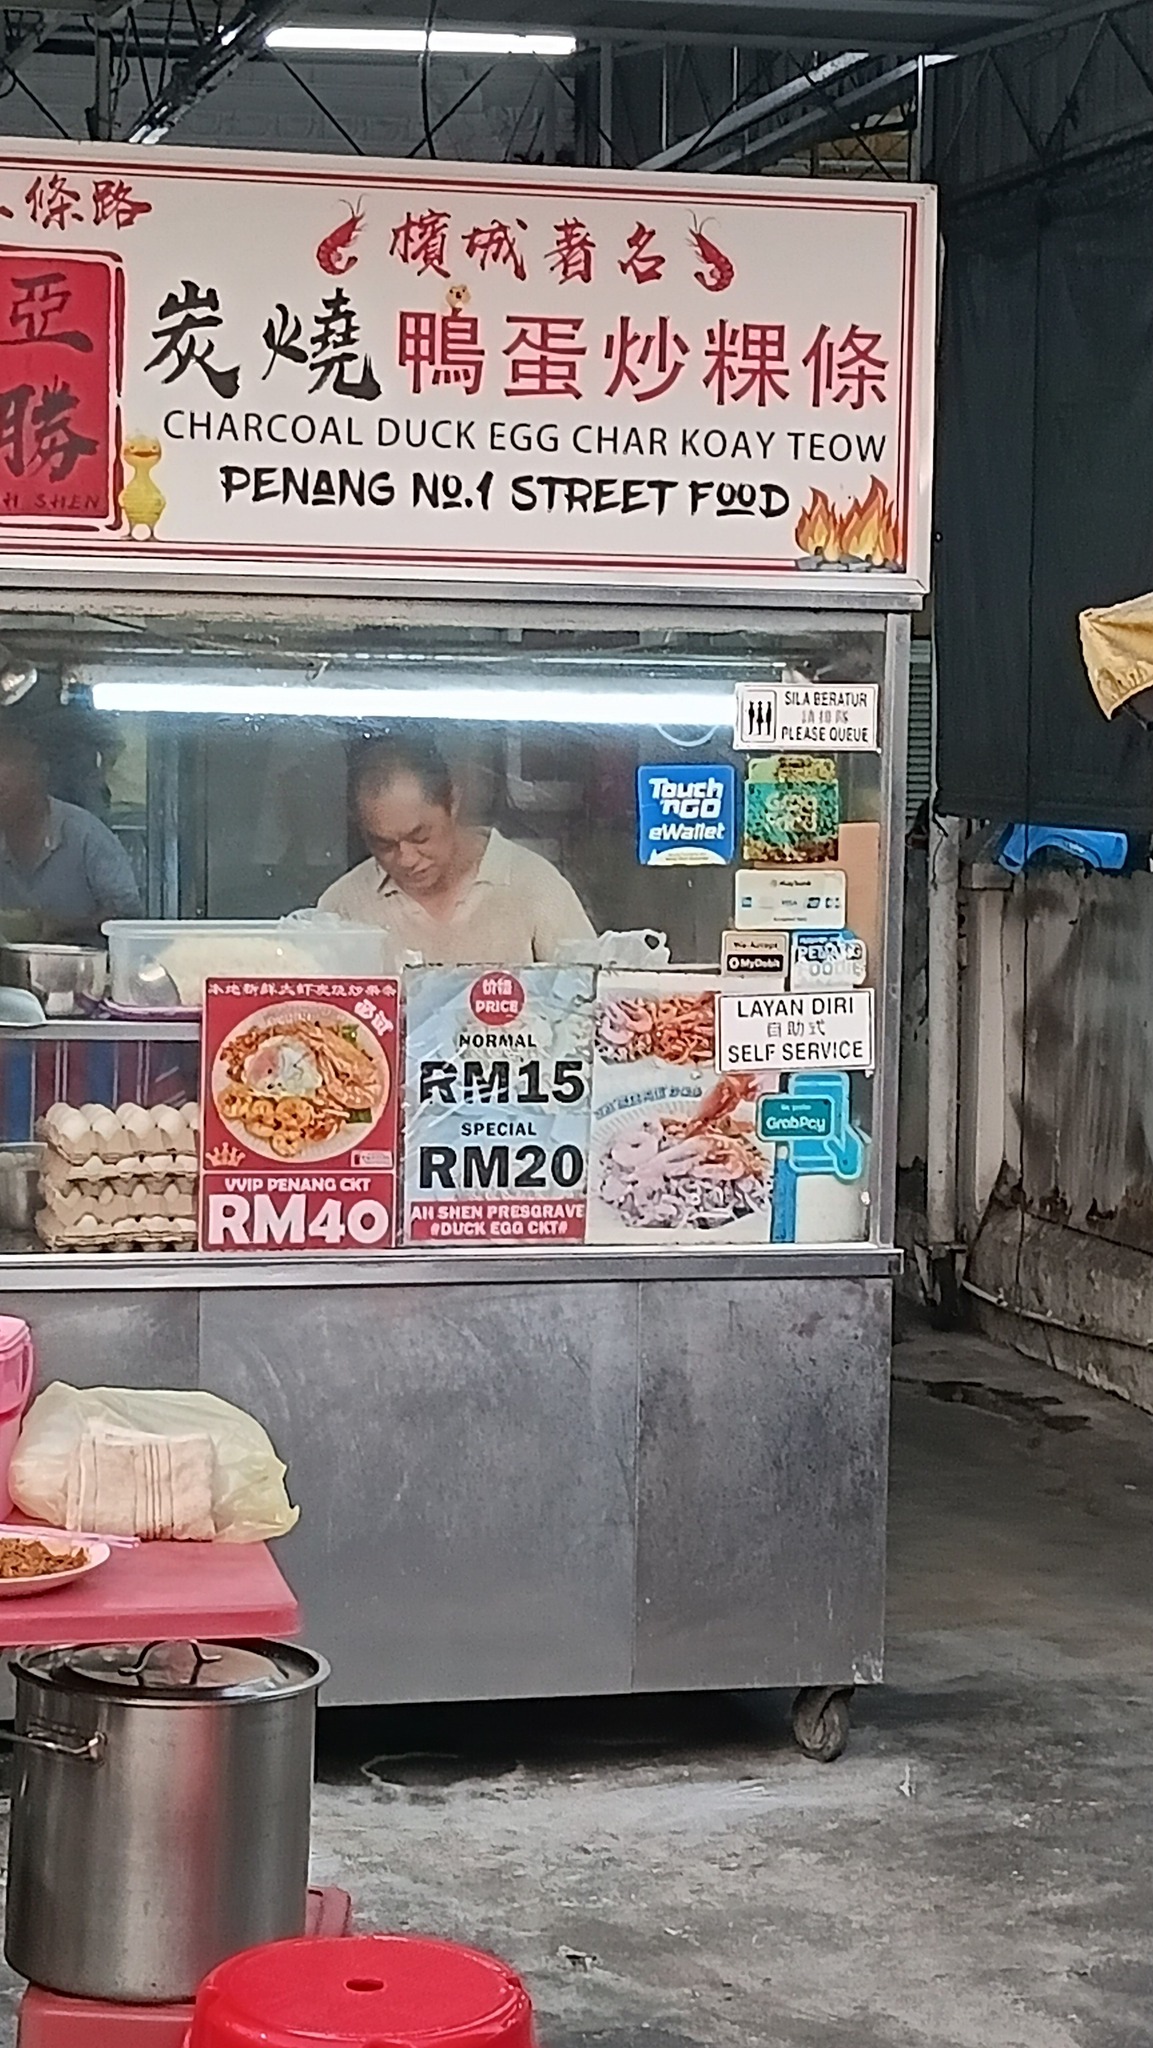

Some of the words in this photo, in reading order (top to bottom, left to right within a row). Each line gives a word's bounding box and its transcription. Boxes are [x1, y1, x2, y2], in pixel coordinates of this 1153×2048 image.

[0, 173, 152, 230] 條路
[163, 410, 363, 446] CHARCOAL
[377, 417, 476, 451] DUCK
[490, 422, 560, 453] EGG
[572, 425, 668, 456] CHAR
[682, 428, 775, 460] KOAY
[787, 431, 887, 462] TEOW
[219, 465, 395, 506] PENANG
[511, 475, 678, 515] STREET
[689, 480, 789, 518] FOOD
[34, 492, 101, 510] SHEN
[785, 691, 810, 706] SILA
[813, 691, 867, 707] BERATUR
[781, 726, 826, 741] PLEASE
[829, 727, 869, 742] QUEUE
[648, 777, 725, 799] Touch
[648, 822, 726, 841] eWallet
[475, 1000, 519, 1014] PRICE
[737, 998, 803, 1018] LAYAN
[812, 997, 854, 1016] DIRI
[458, 1033, 537, 1049] NORMAL
[728, 1043, 775, 1063] SELF
[782, 1040, 864, 1061] SERVICE
[419, 1060, 585, 1104] RM15
[461, 1122, 537, 1137] SPECIAL
[766, 1116, 826, 1133] GrabPay
[419, 1145, 584, 1189] RM20
[224, 1178, 262, 1192] VVIP
[267, 1178, 337, 1193] PENANG
[340, 1178, 371, 1192] CKT
[208, 1193, 389, 1244] RM40
[437, 1205, 483, 1219] SHEN
[486, 1204, 585, 1218] PRESGRAVE
[490, 1221, 524, 1235] EGG
